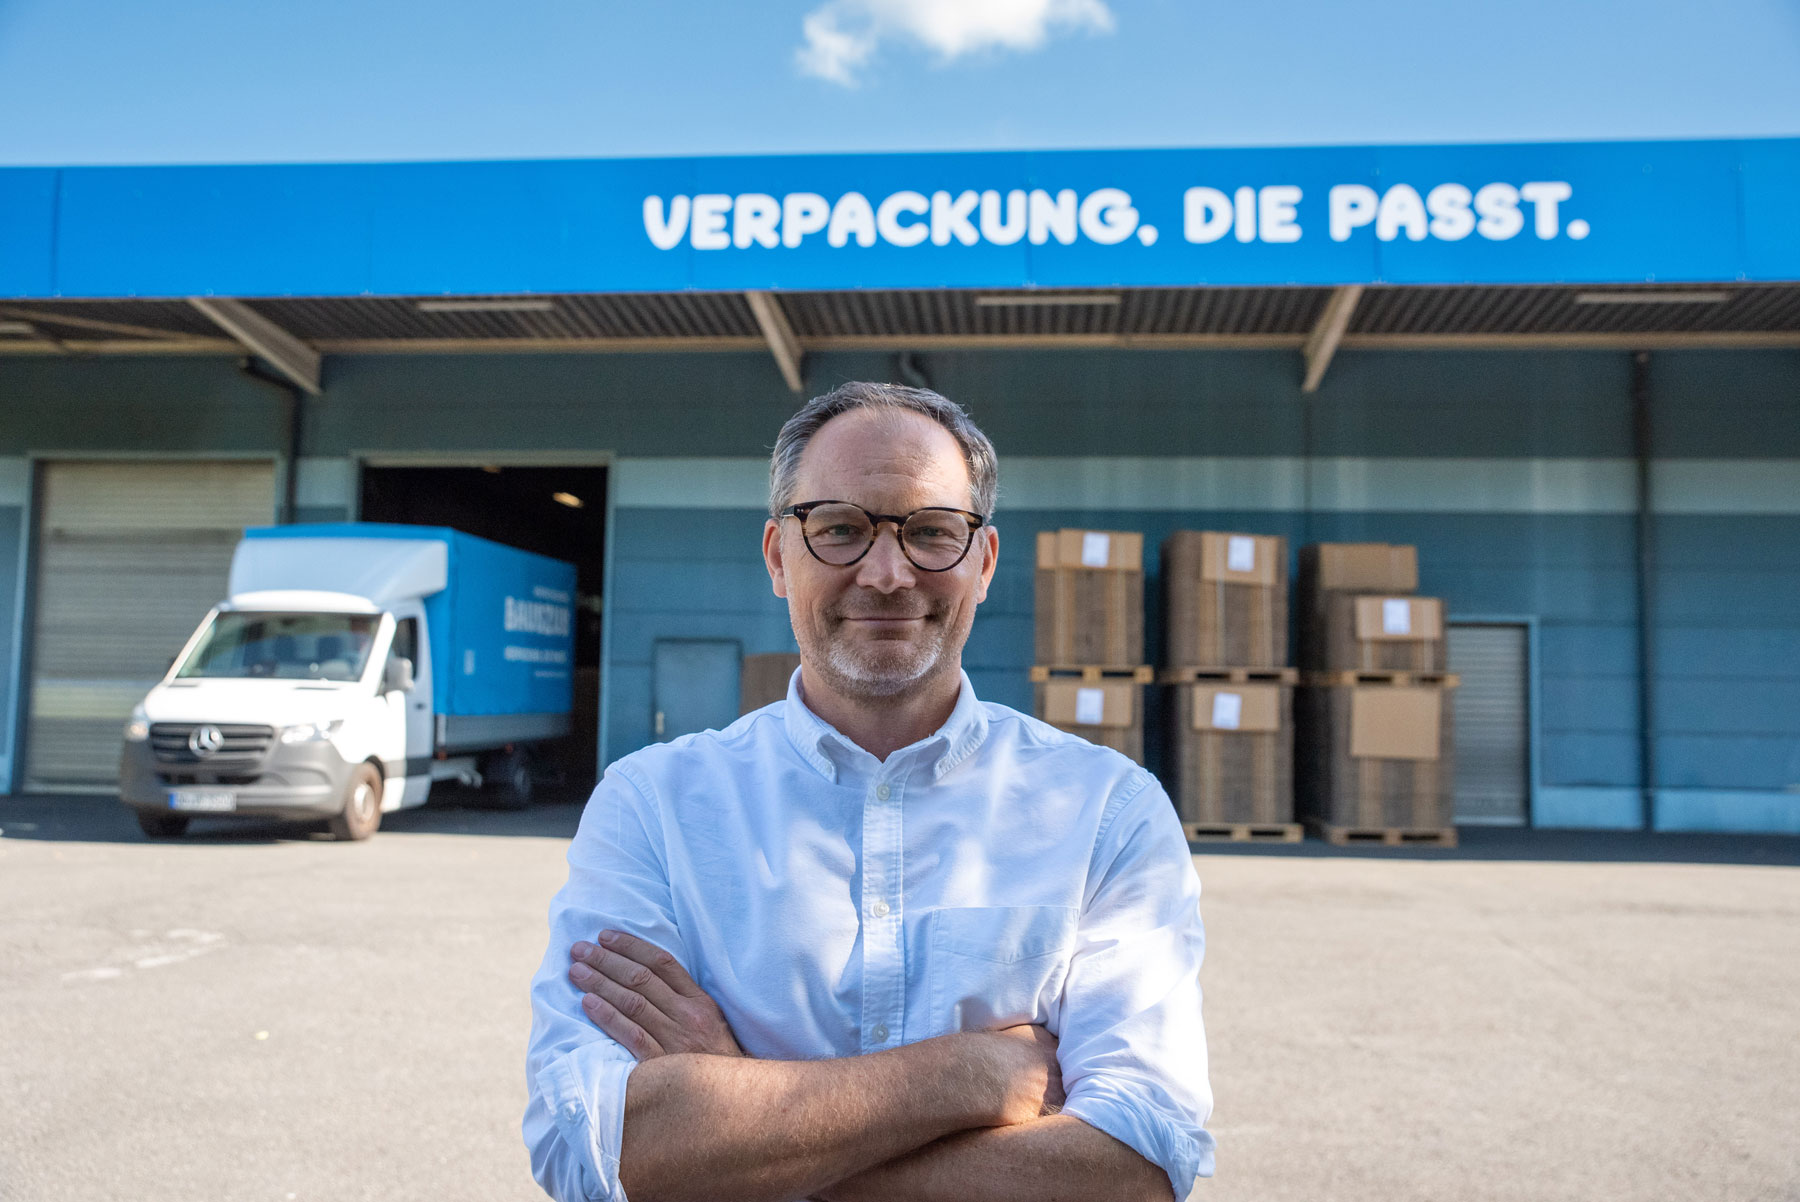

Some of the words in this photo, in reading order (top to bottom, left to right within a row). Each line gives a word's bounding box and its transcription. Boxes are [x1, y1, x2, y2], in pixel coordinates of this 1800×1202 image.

[643, 188, 1159, 250] VERPACKUNG,
[1183, 185, 1303, 244] DIE
[1329, 181, 1590, 242] PASST.
